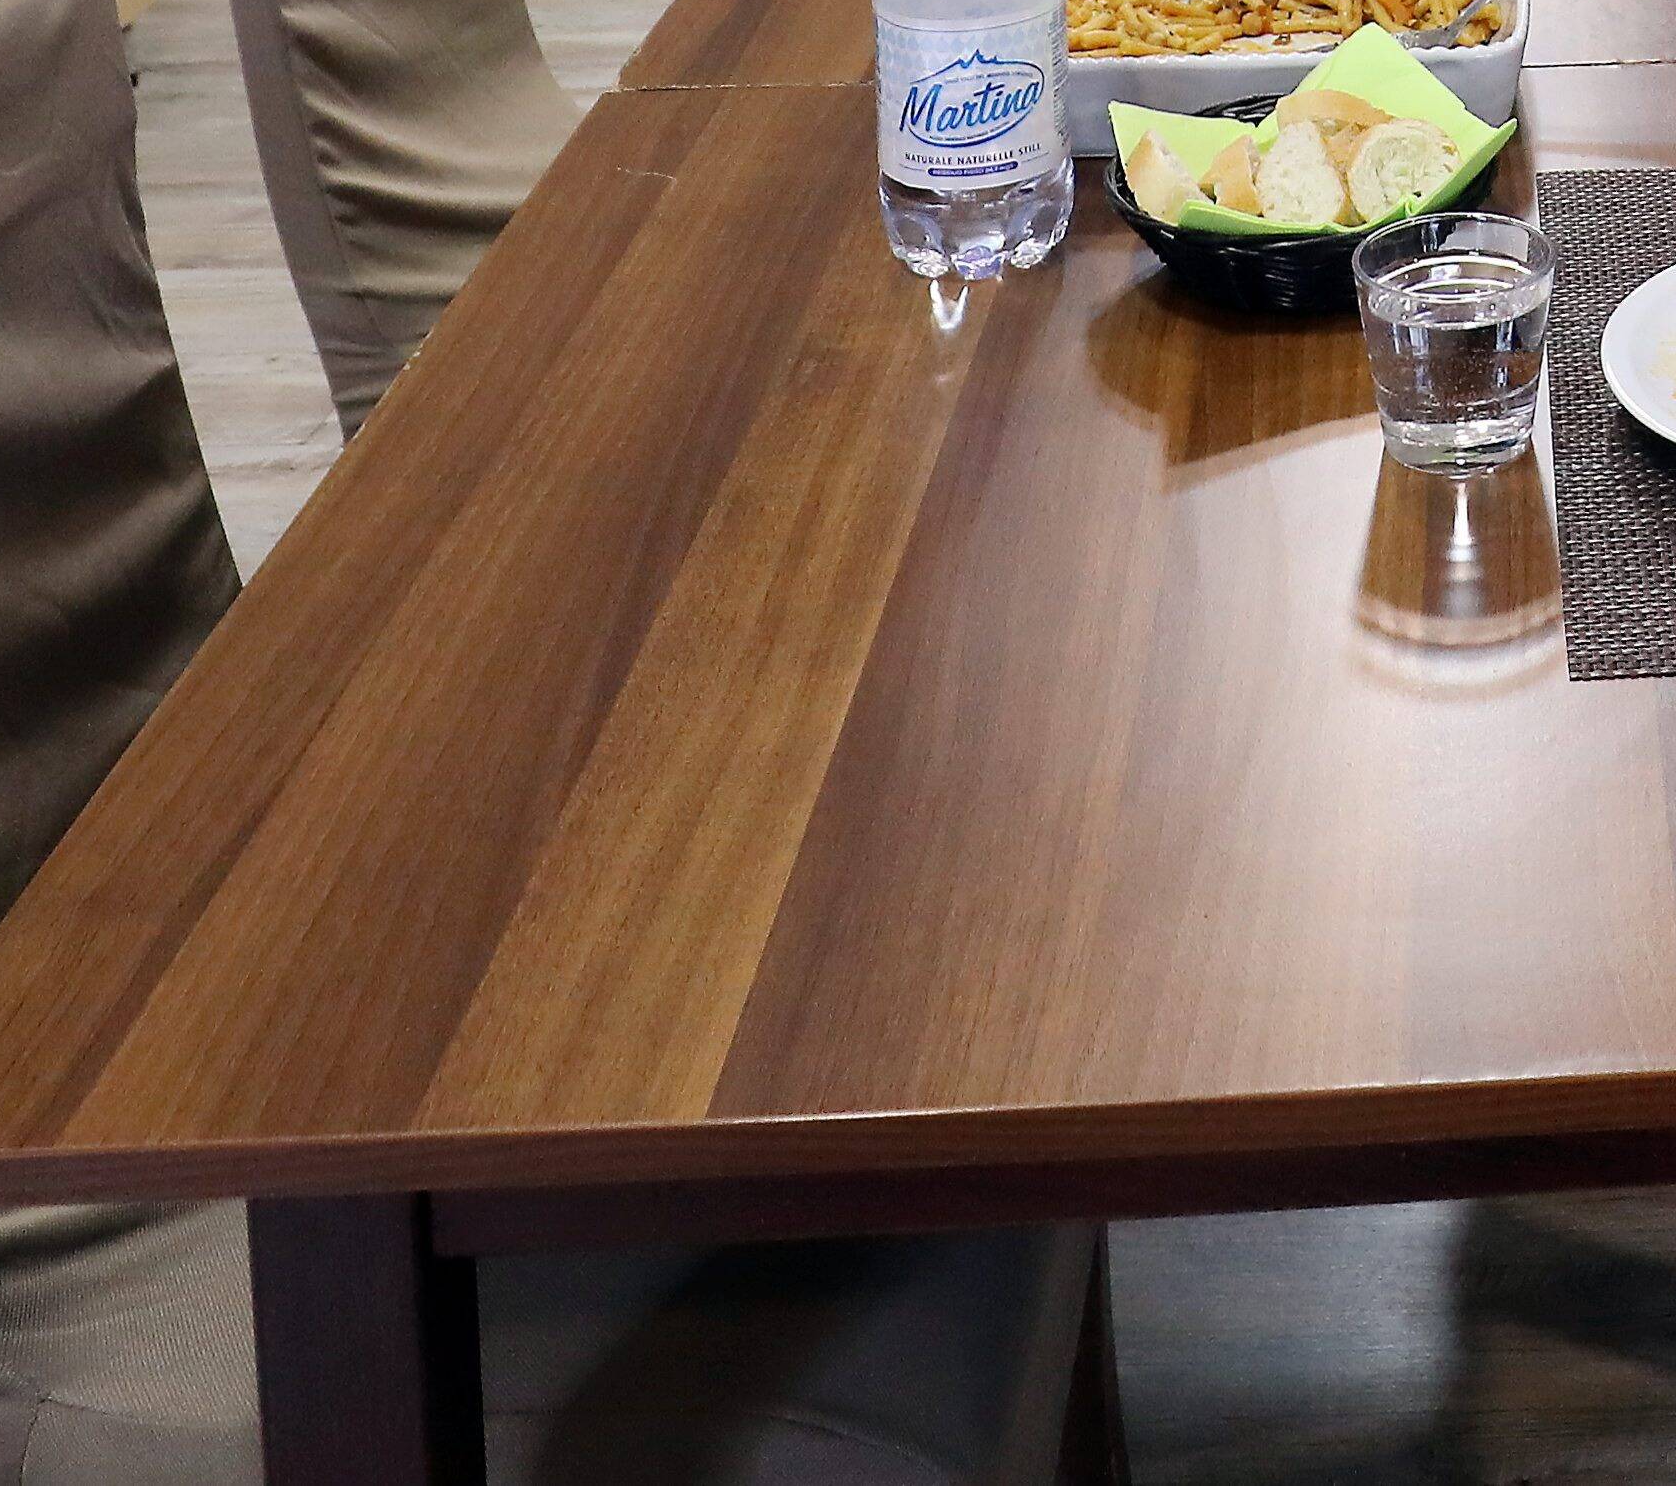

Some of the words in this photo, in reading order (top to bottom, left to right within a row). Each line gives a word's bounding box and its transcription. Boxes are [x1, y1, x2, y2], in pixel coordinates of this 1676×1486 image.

[899, 79, 1041, 132] Martina
[905, 151, 953, 165] NATURALE
[957, 149, 1014, 165] NATURELLE
[1018, 142, 1041, 155] STILL
